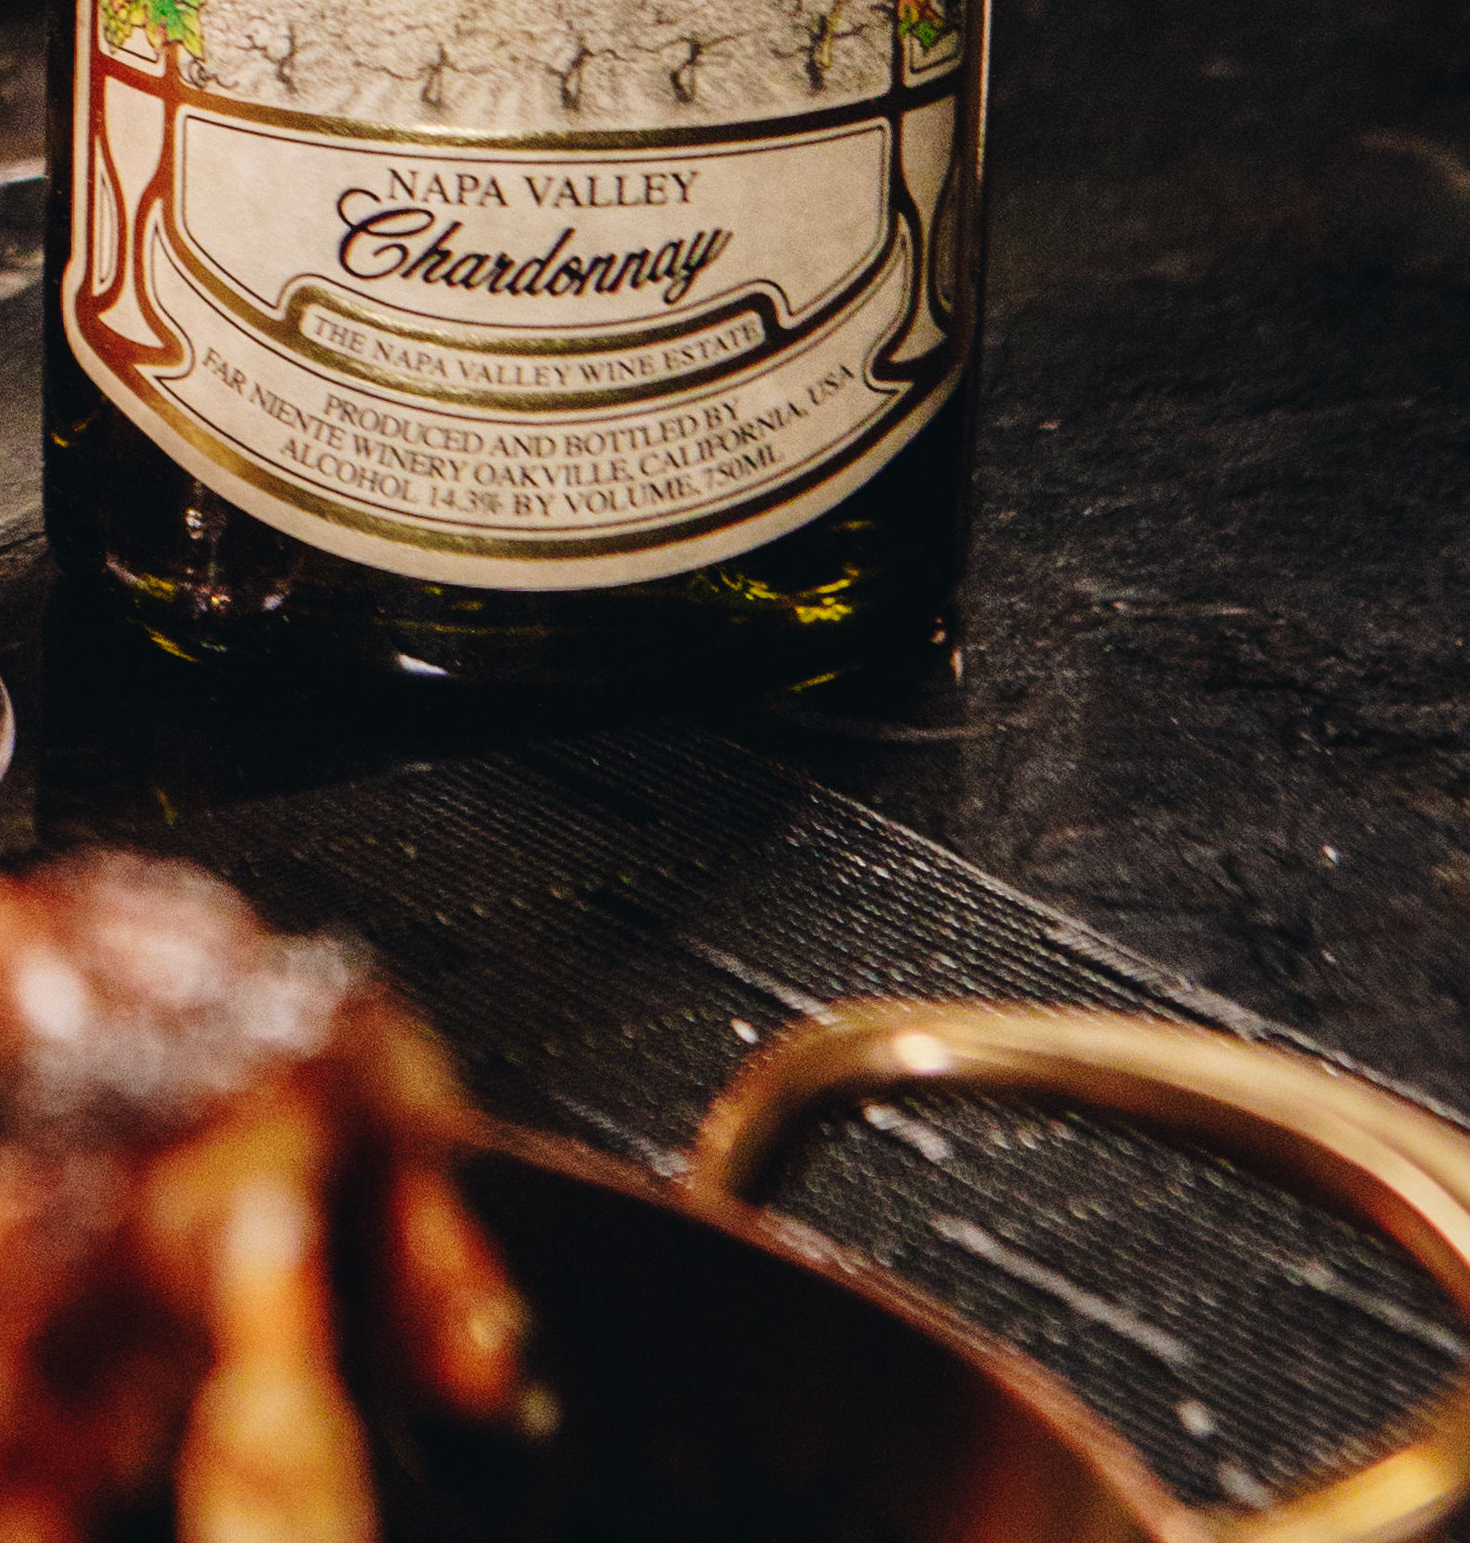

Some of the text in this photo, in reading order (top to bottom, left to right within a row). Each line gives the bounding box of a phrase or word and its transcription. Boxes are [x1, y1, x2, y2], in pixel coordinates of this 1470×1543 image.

[386, 167, 701, 208] NAPA VALLEY
[335, 187, 735, 305] Chardonnay
[313, 314, 759, 387] THE NAPA VALLEY WINE ESTATE
[201, 346, 247, 396] FAR
[249, 382, 344, 446] NIENTE
[350, 432, 468, 484] WINERY
[808, 363, 856, 407] USA
[323, 392, 741, 460] PRODUCED AND BOTTLED BY
[279, 437, 421, 503] ALCOHOL
[513, 492, 552, 517] BY
